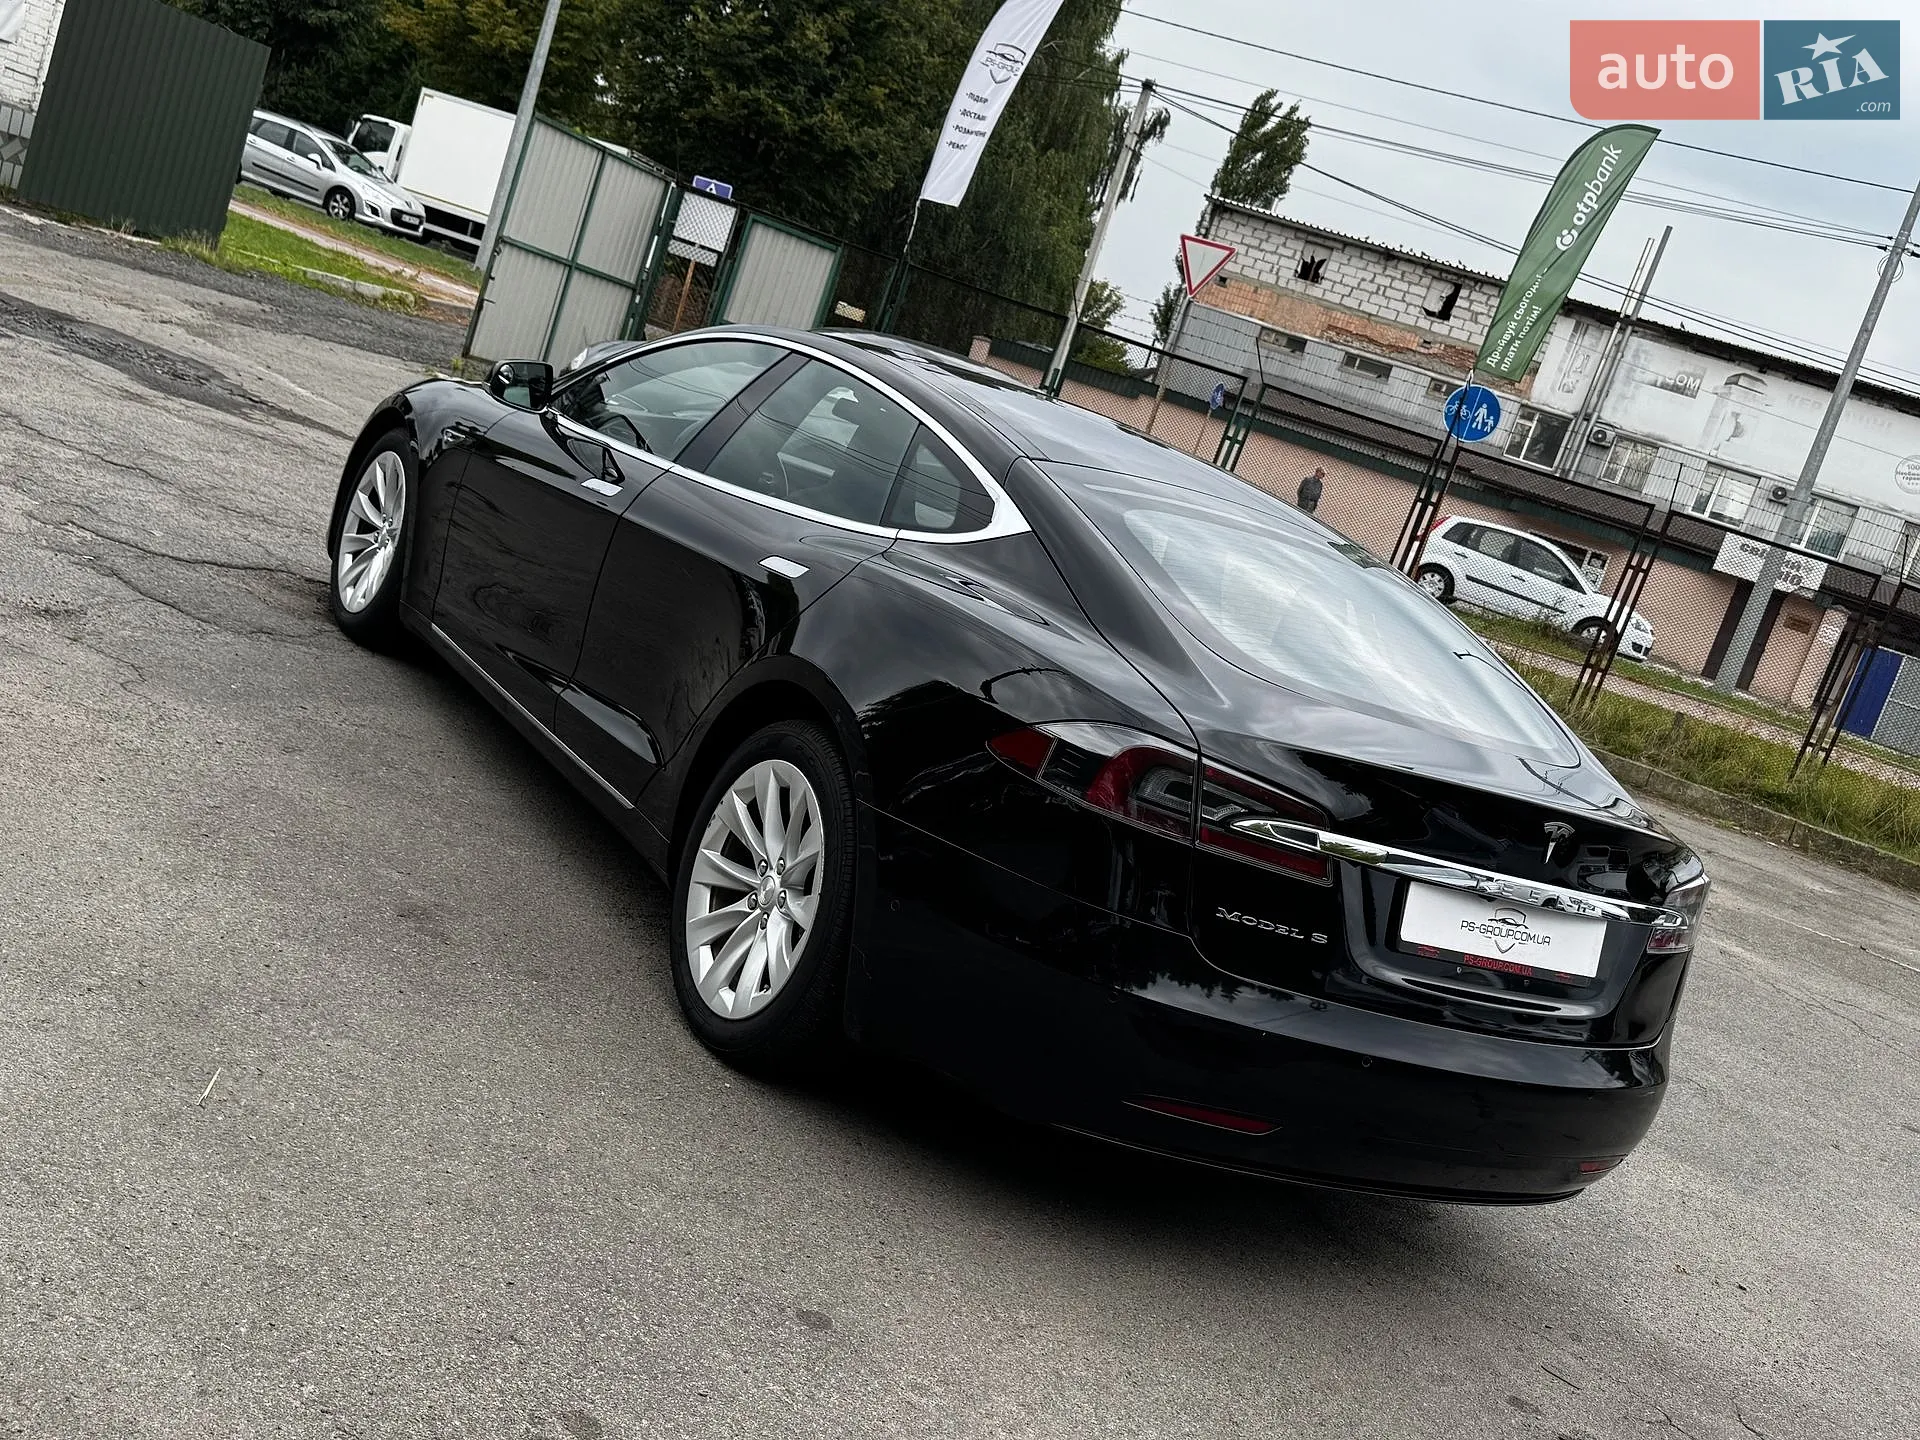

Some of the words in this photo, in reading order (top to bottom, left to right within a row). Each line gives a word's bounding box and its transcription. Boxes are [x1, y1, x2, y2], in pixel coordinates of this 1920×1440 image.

[1572, 143, 1622, 226] otpbank
[1216, 906, 1304, 939] MODEL
[1311, 932, 1328, 944] S
[1460, 920, 1551, 947] PS-GROUP.COM.UA
